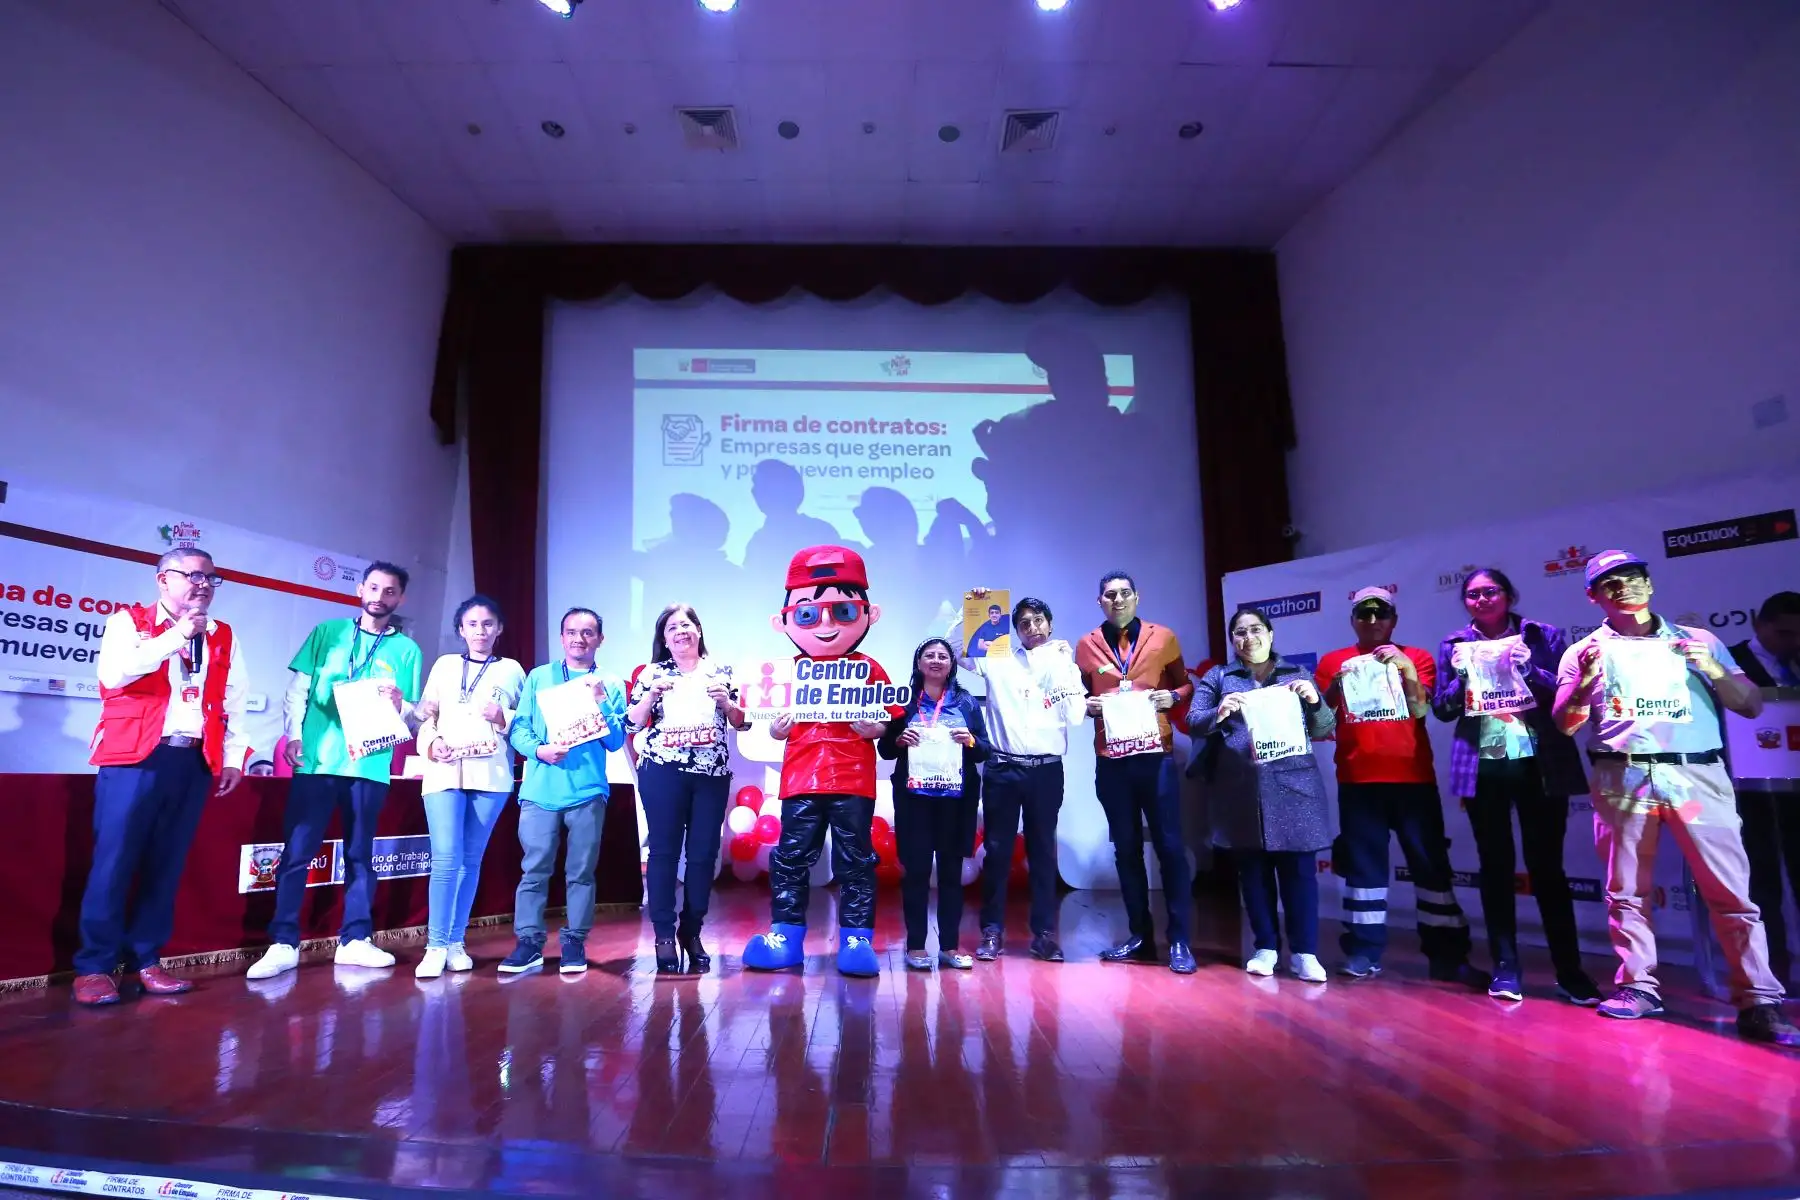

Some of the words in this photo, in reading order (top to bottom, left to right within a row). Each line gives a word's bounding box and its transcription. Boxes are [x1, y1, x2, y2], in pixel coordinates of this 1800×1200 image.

[720, 414, 788, 433] Firma
[793, 415, 822, 433] de
[827, 417, 947, 436] contratos:
[721, 438, 822, 457] Empresas
[826, 442, 864, 458] que
[868, 443, 952, 460] generan
[721, 464, 732, 479] y
[858, 463, 934, 482] empleo
[1668, 526, 1740, 547] EQUINOX
[33, 585, 73, 609] de
[797, 660, 868, 681] Centro
[796, 684, 822, 705] de
[827, 684, 908, 707] Empleo
[1482, 690, 1517, 700] Centro
[1483, 702, 1496, 711] de
[831, 711, 841, 720] tu
[845, 710, 889, 720] trabajo.
[362, 734, 396, 748] Centro
[1256, 740, 1286, 750] Centro
[1257, 751, 1268, 760] de
[386, 854, 398, 862] de
[400, 852, 429, 861] Trabajo
[396, 861, 409, 871] del
[4, 1164, 24, 1172] FIRMA
[0, 1172, 39, 1183] CONTRATOS
[106, 1175, 128, 1185] FIRMA
[129, 1177, 140, 1185] DE
[102, 1184, 145, 1195] CONTRATOS
[178, 1189, 198, 1198] Empleo
[217, 1188, 242, 1198] FIRMA
[242, 1190, 253, 1199] DE
